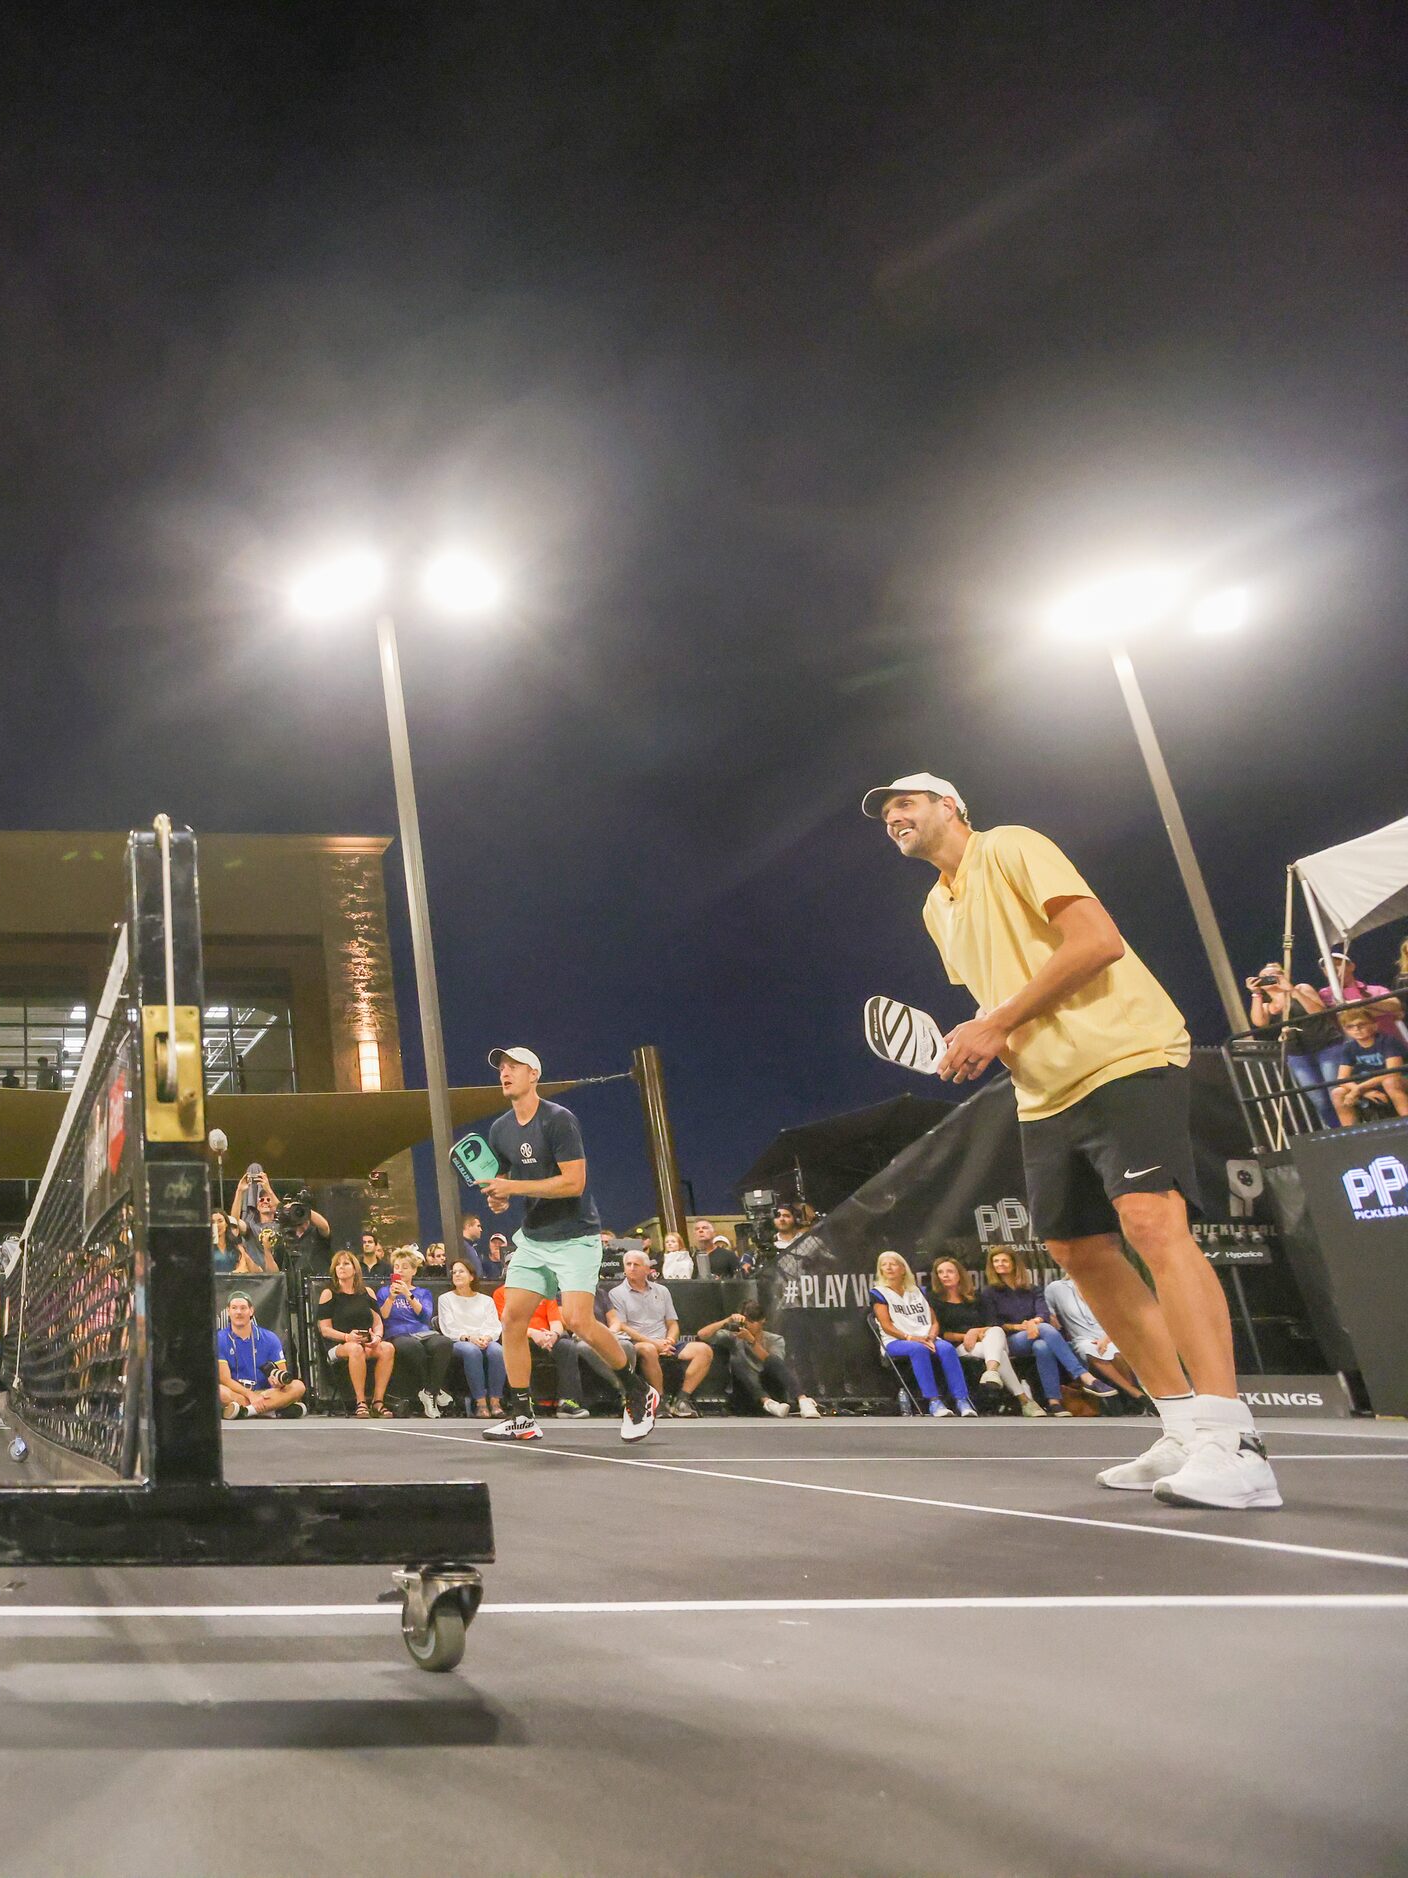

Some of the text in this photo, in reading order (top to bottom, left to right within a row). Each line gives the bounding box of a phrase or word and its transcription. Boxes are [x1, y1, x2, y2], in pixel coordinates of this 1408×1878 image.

[1342, 1155, 1408, 1210] PP
[1353, 1205, 1408, 1220] PICKLEBAL
[981, 1244, 1034, 1253] PICBALL
[1225, 1251, 1264, 1259] Hyperice
[784, 1273, 849, 1309] #PLAY
[893, 1303, 925, 1316] DALLAS
[917, 1315, 929, 1326] 41
[505, 1420, 535, 1431] adidas
